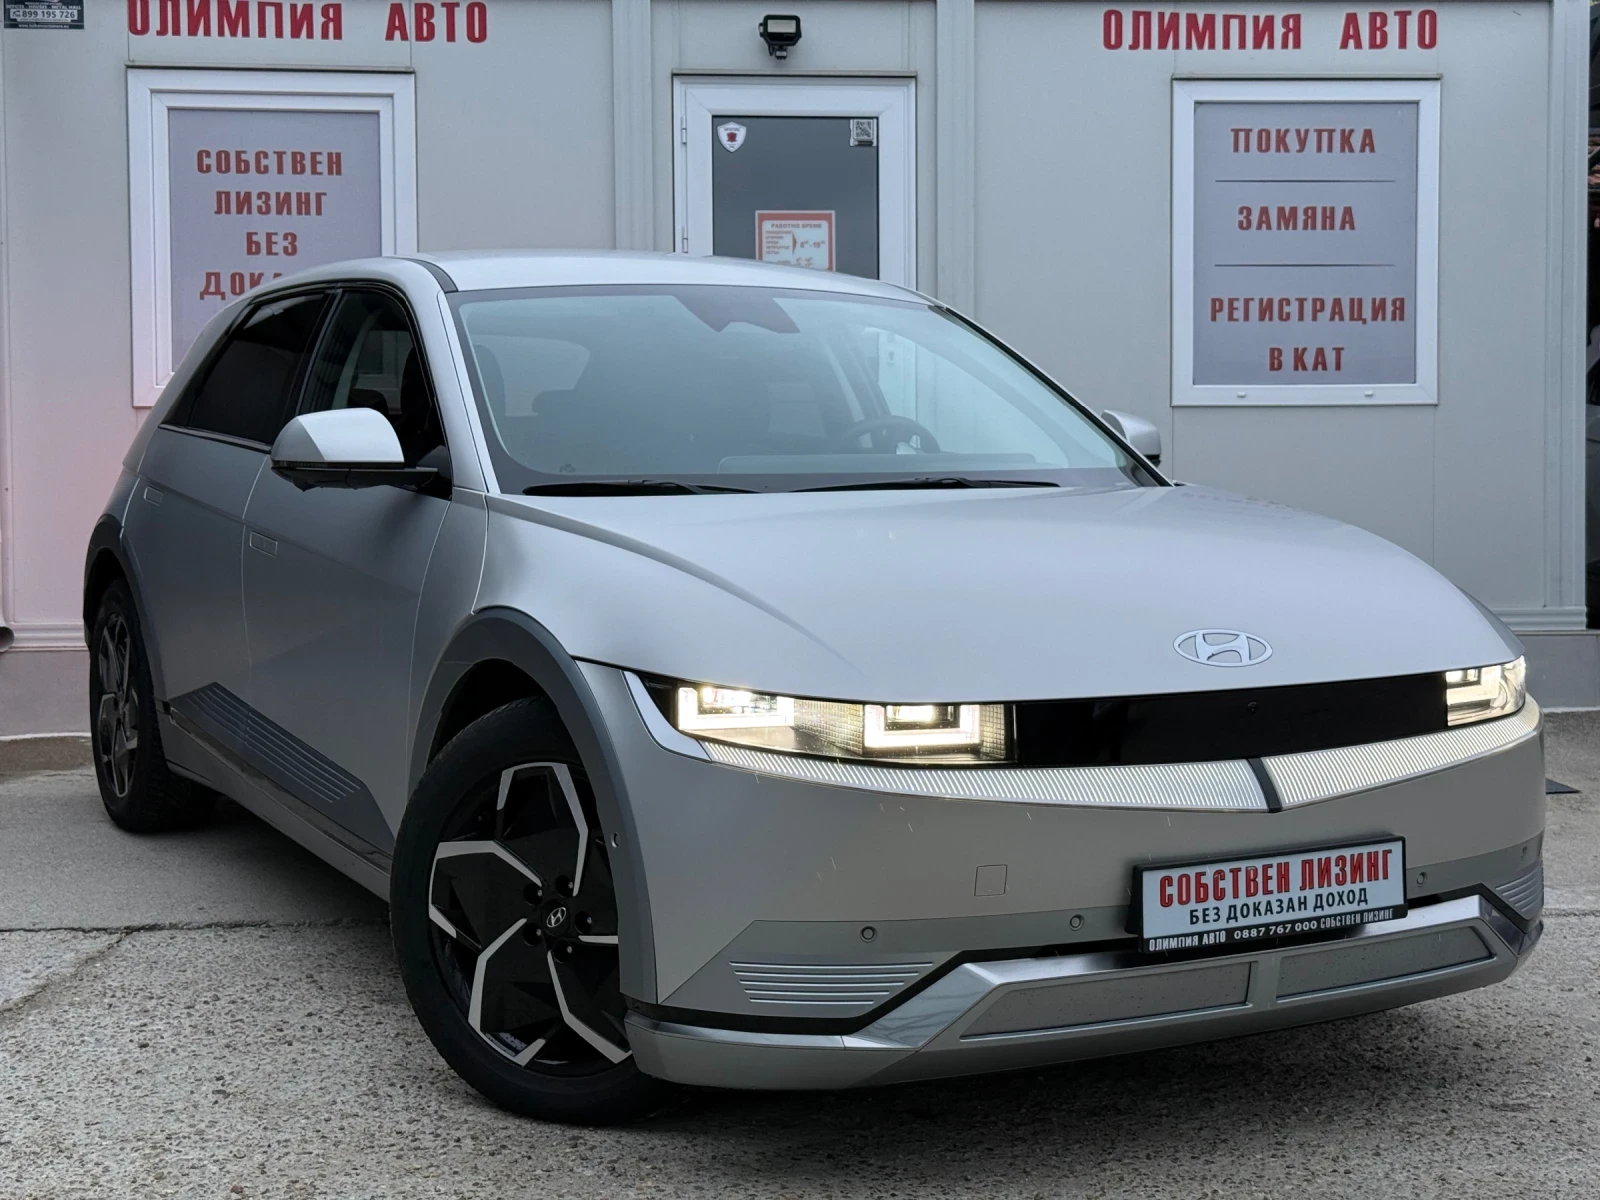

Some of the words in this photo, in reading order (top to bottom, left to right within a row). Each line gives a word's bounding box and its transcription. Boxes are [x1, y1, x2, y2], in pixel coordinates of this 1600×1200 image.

[22, 10, 38, 18] 899
[41, 10, 56, 18] 195
[128, 0, 343, 40] ОЛИМПИЯ
[385, 2, 488, 43] АВТО
[1103, 9, 1301, 50] ОЛИМПИЯ
[1339, 9, 1437, 50] АВТО
[1230, 128, 1376, 154] ПОКУПКА
[197, 150, 342, 176] СОБСТВЕН
[214, 190, 327, 216] ЛИЗИНГ
[1237, 206, 1356, 231] ЗАМЯНА
[246, 232, 298, 256] БЕЗ
[200, 272, 282, 300] ДОК
[1210, 297, 1405, 324] РЕГИСТРАЦИЯ
[1269, 347, 1283, 371] В
[1293, 347, 1345, 371] КАТ
[1160, 862, 1290, 908] СОБСТВЕН
[1299, 849, 1392, 891] ЛИЗИНГ
[1190, 907, 1221, 925] БЕЗ
[1226, 896, 1307, 924] ДОКАЗАН
[1313, 888, 1368, 912] ДОХОД
[1149, 935, 1199, 951] ОЛИМПИЯ
[1202, 930, 1226, 945] АВТО
[1234, 928, 1266, 939] 0887
[1269, 924, 1291, 935] 767
[1295, 921, 1317, 932] 000
[1320, 913, 1360, 929] СОБСТВЕН
[1363, 909, 1394, 923] ЛИЗИНГ
